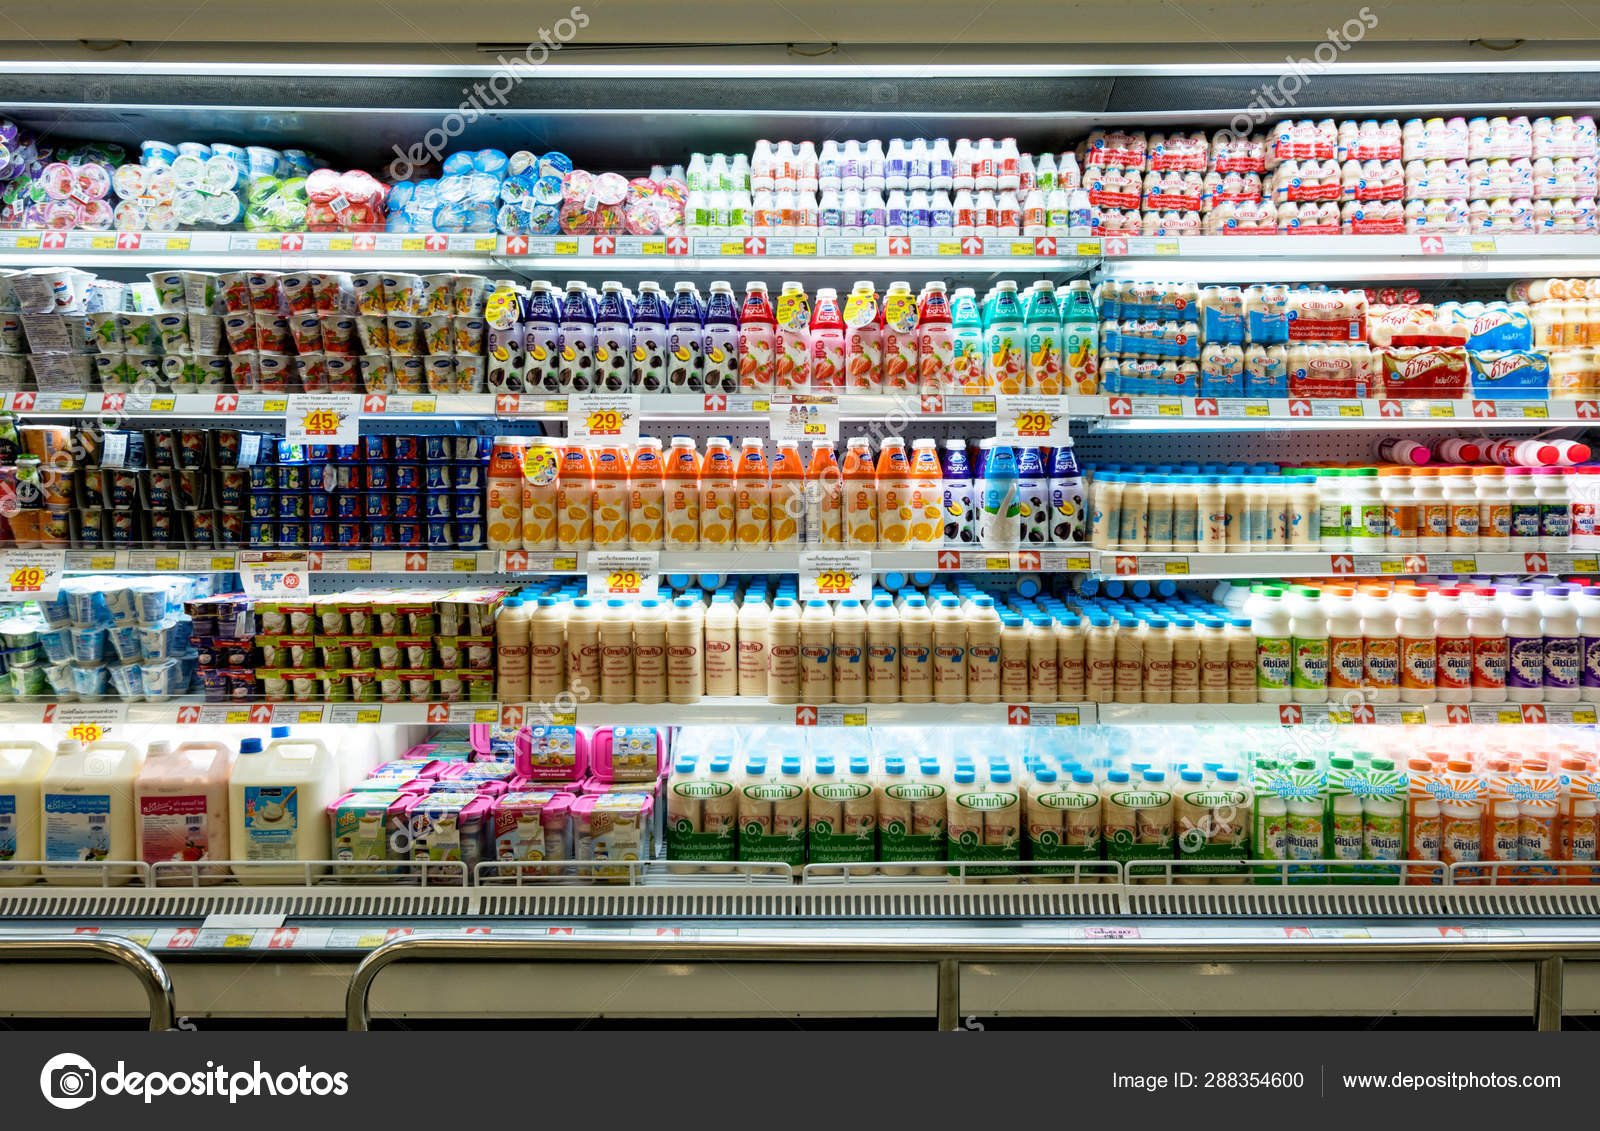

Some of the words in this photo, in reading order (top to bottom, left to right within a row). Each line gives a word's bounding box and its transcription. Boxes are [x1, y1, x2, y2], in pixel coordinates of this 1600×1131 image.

[309, 413, 333, 429] 45
[593, 414, 617, 429] 29
[1022, 415, 1046, 431] 29
[16, 570, 39, 585] 49
[612, 574, 636, 588] 29
[822, 574, 846, 588] 29
[73, 727, 96, 741] 58
[684, 784, 726, 796] บีทาเก้น
[754, 784, 792, 797] บีทาเก้น
[825, 784, 864, 797] บีทาเก้น
[896, 784, 937, 797] บีทาเก้น
[968, 793, 1008, 806] บีทาเก้น
[1050, 793, 1089, 806] บีทาเก้น
[1123, 792, 1163, 805] บีทาเก้น
